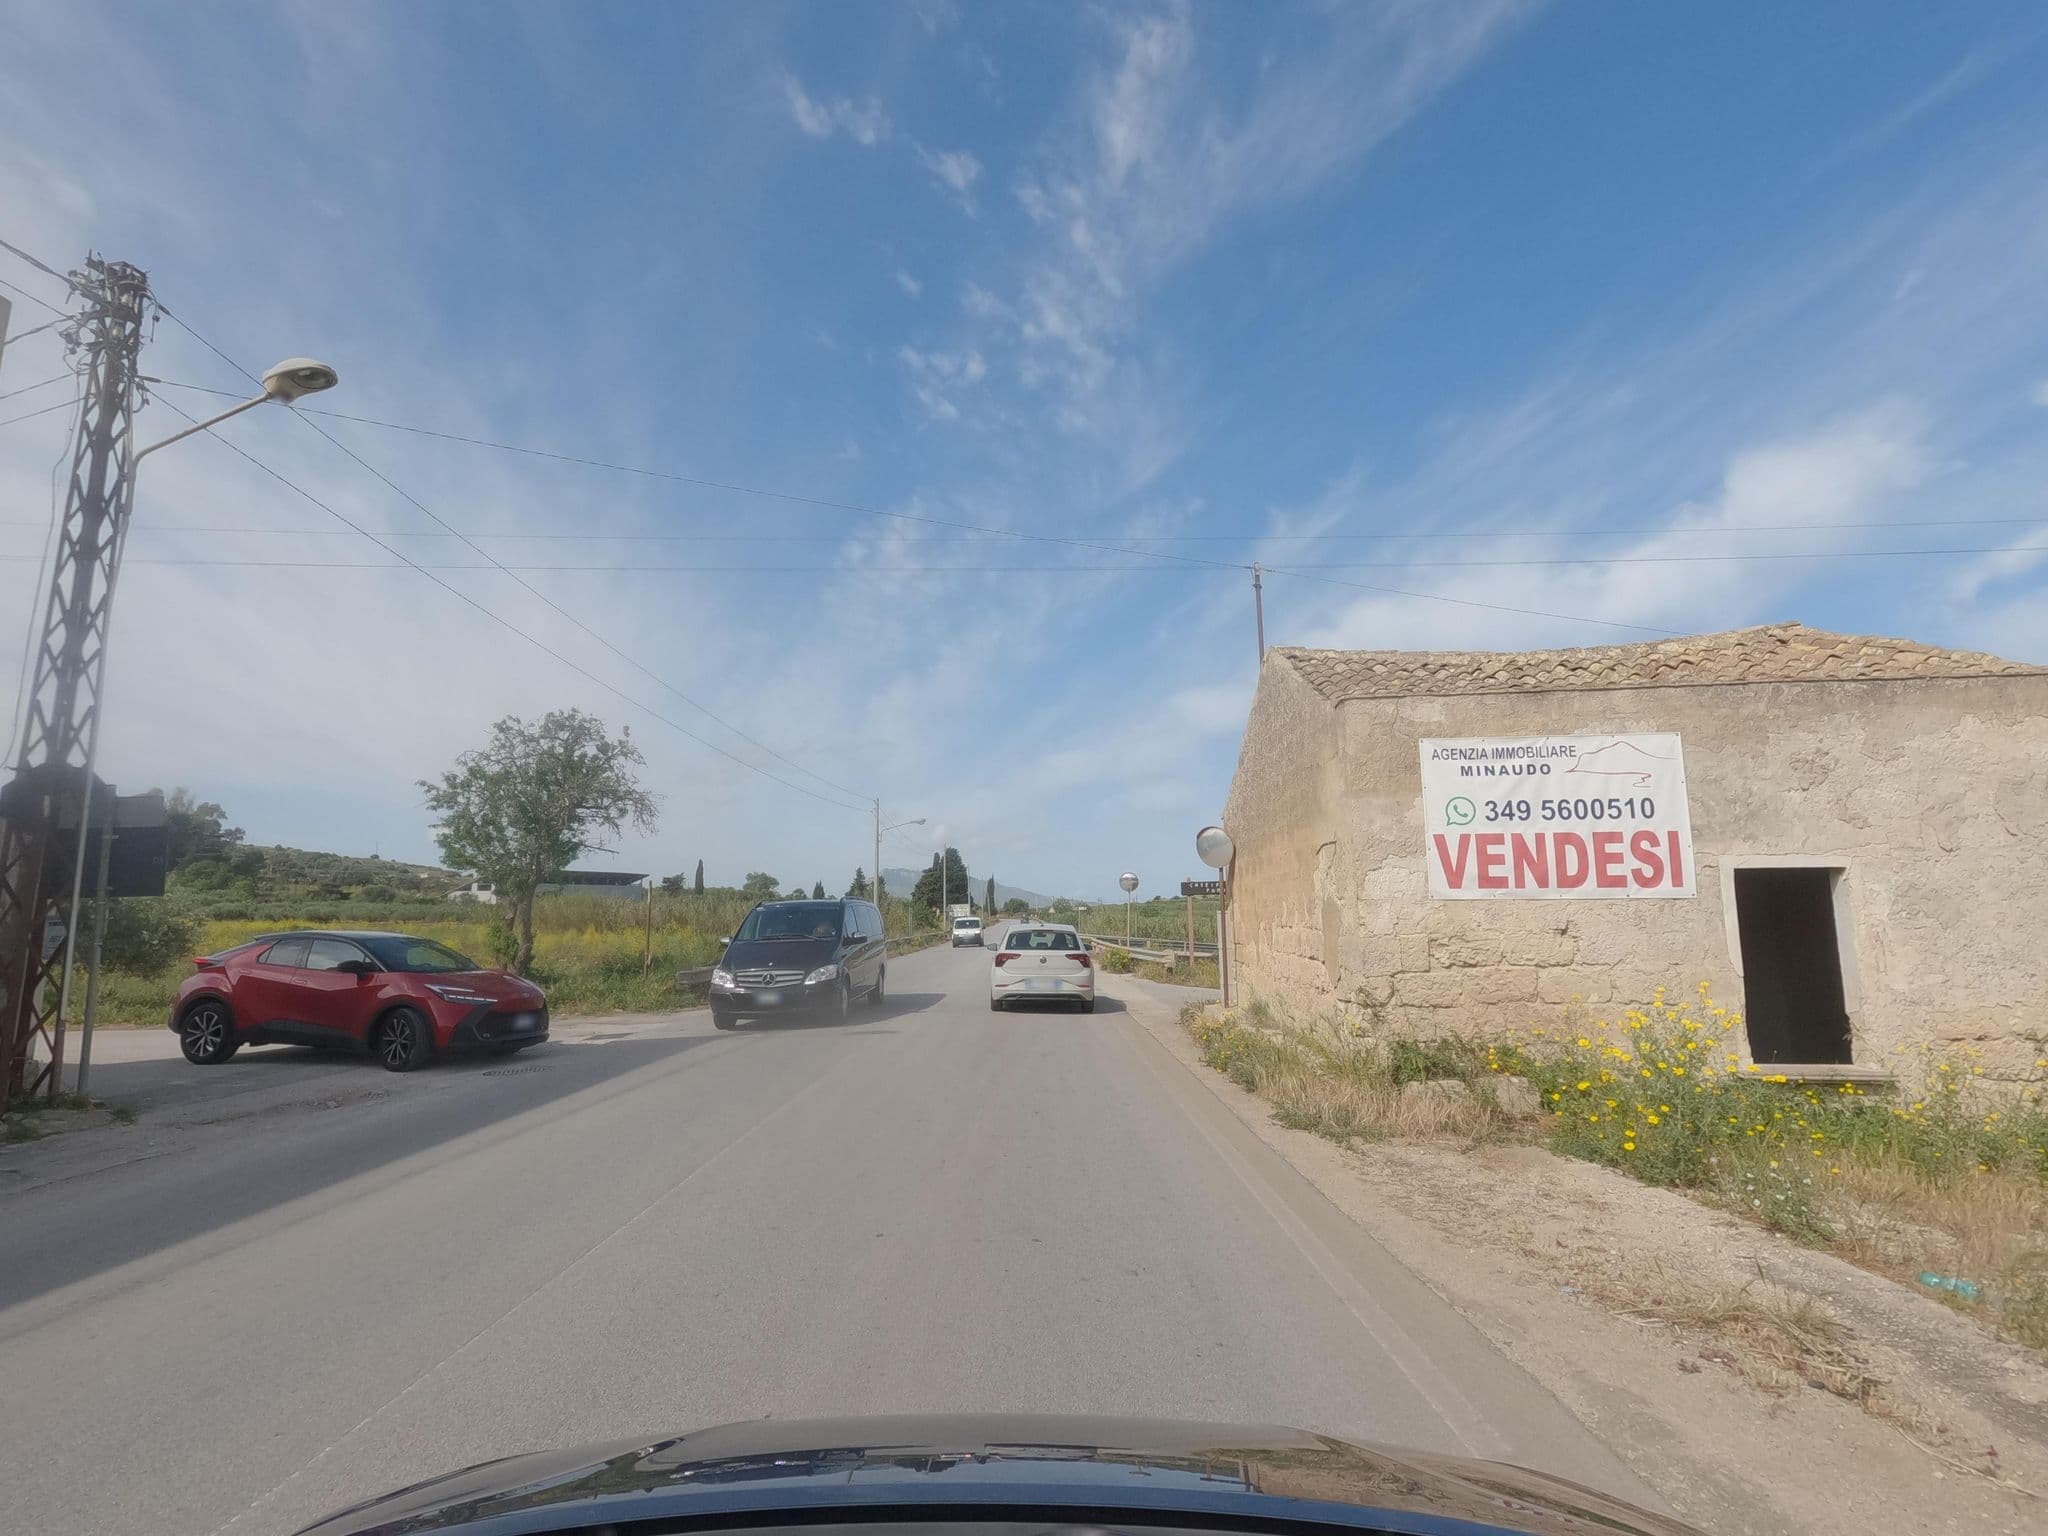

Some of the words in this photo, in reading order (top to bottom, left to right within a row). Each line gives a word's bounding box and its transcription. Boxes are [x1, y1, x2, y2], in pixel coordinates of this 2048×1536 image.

[1432, 748, 1489, 760] AGENZIA
[1491, 745, 1577, 759] IMMOBILIARE
[1460, 763, 1551, 776] MINAUDO
[1484, 800, 1531, 822] 349
[1541, 797, 1655, 821] 5600510
[1433, 830, 1684, 889] VENDESI
